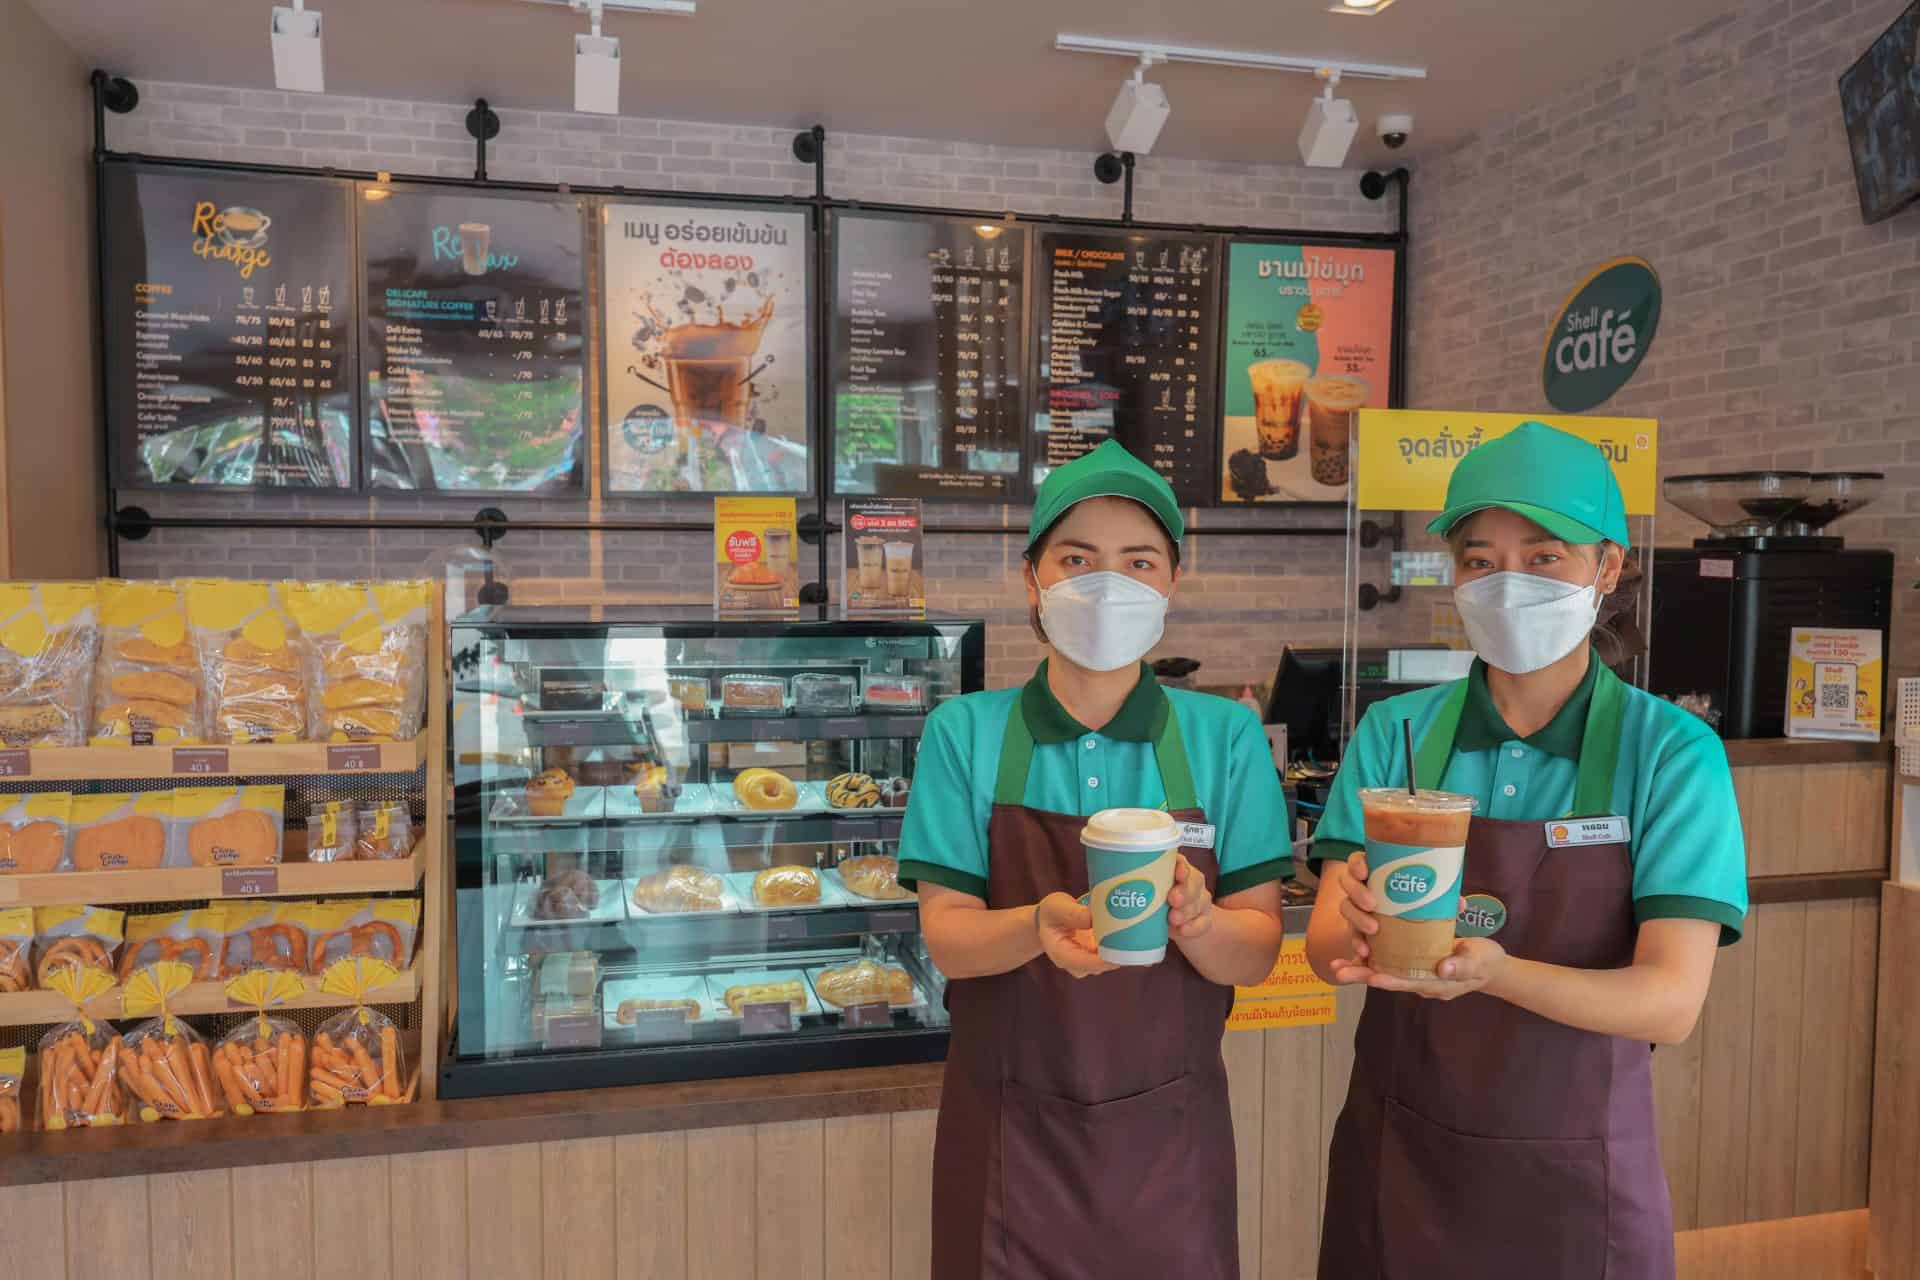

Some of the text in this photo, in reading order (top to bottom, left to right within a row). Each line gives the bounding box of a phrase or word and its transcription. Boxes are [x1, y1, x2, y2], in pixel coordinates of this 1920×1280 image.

[624, 219, 788, 246] เมนู อร่อยเข้มข้น
[660, 248, 754, 271] ต้องลอง
[1081, 251, 1125, 261] CHOCOLATE
[1258, 255, 1365, 288] ชานมไข่มุก
[440, 302, 473, 311] COFFEE
[1568, 307, 1599, 333] Shell
[1555, 309, 1636, 374] café
[1390, 875, 1428, 893] café
[1110, 891, 1147, 908] café
[1456, 909, 1496, 929] café
